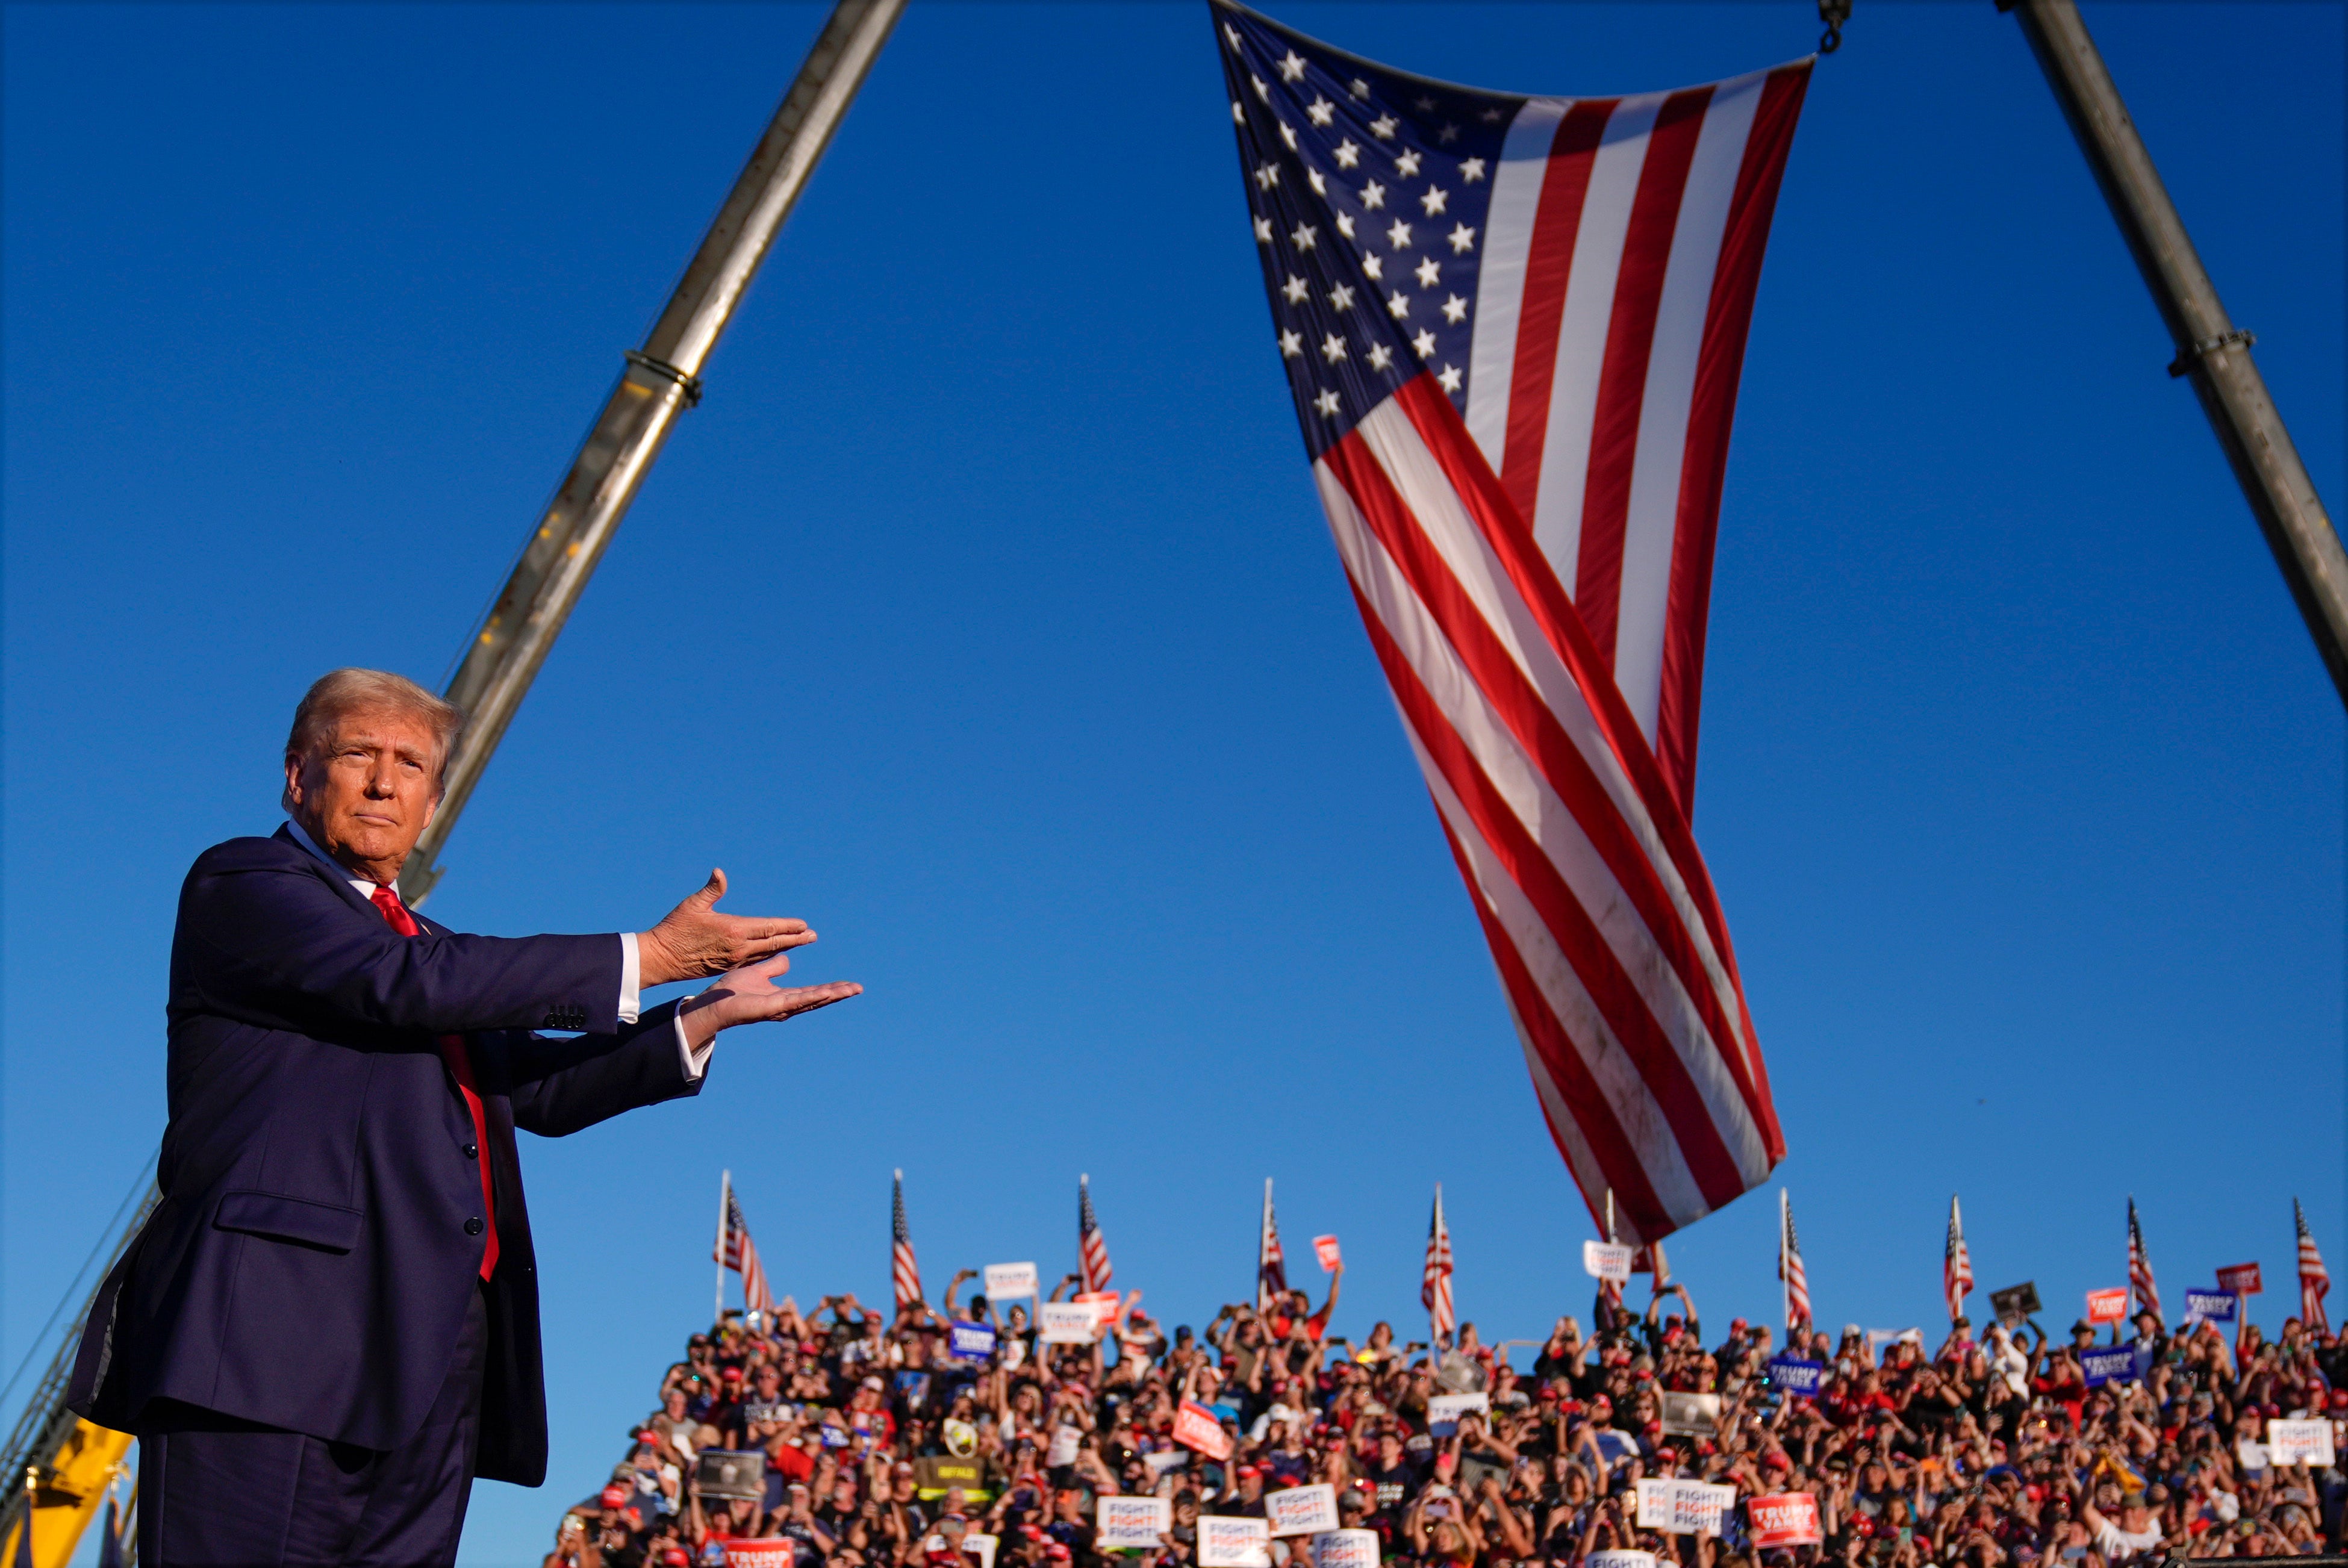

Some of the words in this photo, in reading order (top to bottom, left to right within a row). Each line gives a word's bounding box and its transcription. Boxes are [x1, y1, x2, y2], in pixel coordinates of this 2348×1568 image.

[2188, 1295, 2233, 1304] TRUMP
[2083, 1352, 2132, 1367] TRUMP
[1771, 1365, 1817, 1377] TRUMP
[2280, 1437, 2325, 1446] FIGHT!
[1277, 1491, 1324, 1504] FIGHT!
[1677, 1490, 1725, 1502] FIGHT!
[1109, 1504, 1157, 1513] FIGHT!
[1278, 1502, 1325, 1514] FIGHT!
[1676, 1501, 1721, 1514] FIGHT
[1754, 1505, 1813, 1522] TRUMP
[1109, 1516, 1157, 1525] FIGHT!
[1279, 1513, 1326, 1526] FIGHT!
[1675, 1514, 1719, 1526] FIGHT
[1763, 1516, 1809, 1530] VANCE
[1109, 1528, 1157, 1537] FIGHT!
[1210, 1524, 1258, 1534] FIGHT!
[1320, 1537, 1368, 1549] FIGHT!
[727, 1551, 788, 1563] TRUMP
[1320, 1549, 1369, 1560] FIGHT!
[1593, 1558, 1646, 1568] FIGHT!
